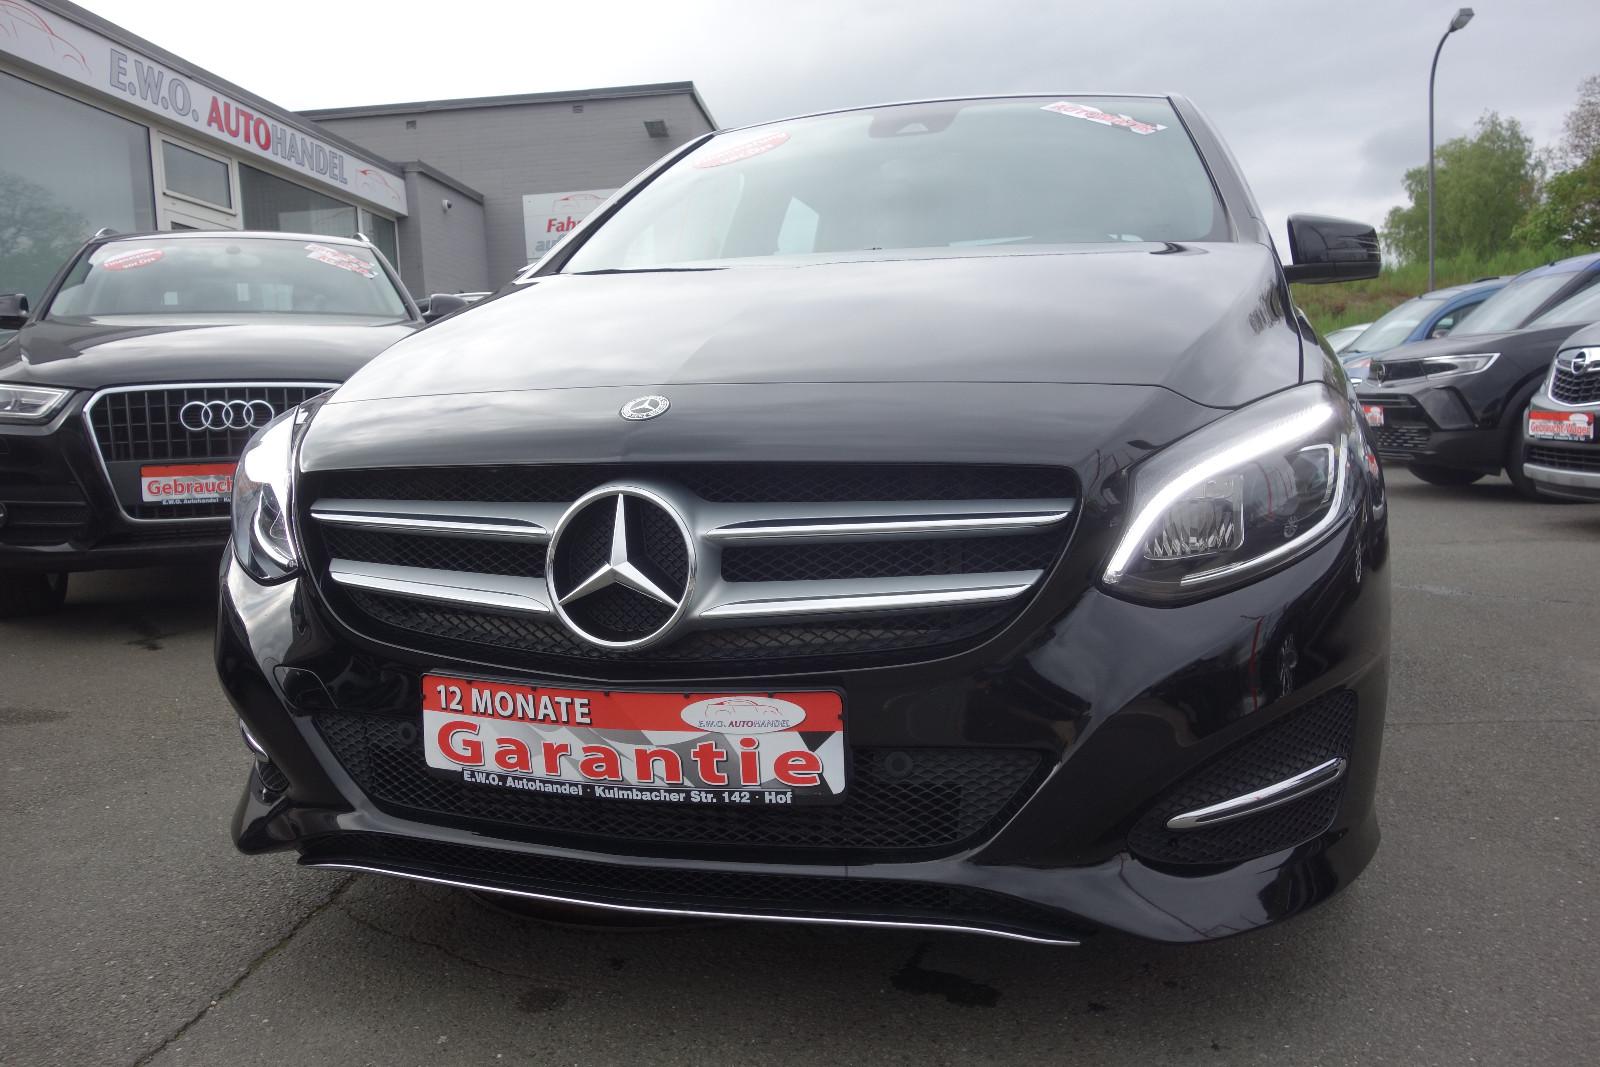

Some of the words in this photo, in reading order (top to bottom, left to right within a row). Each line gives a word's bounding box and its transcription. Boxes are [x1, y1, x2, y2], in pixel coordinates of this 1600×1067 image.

[109, 48, 199, 122] E.W.O.
[207, 95, 348, 185] AUTOHANDEL
[546, 216, 582, 233] Fah
[436, 684, 464, 712] 12
[470, 687, 592, 725] MONATE
[698, 720, 727, 728] E.W.O.
[728, 719, 791, 728] AUTOHANDEL
[436, 720, 824, 787] Garantie
[463, 772, 503, 788] E.W.O.
[506, 776, 583, 796] Autohandel
[594, 785, 685, 802] Kulmbacher
[690, 789, 717, 803] Str.
[722, 790, 751, 804] 142
[764, 789, 793, 804] Hof
